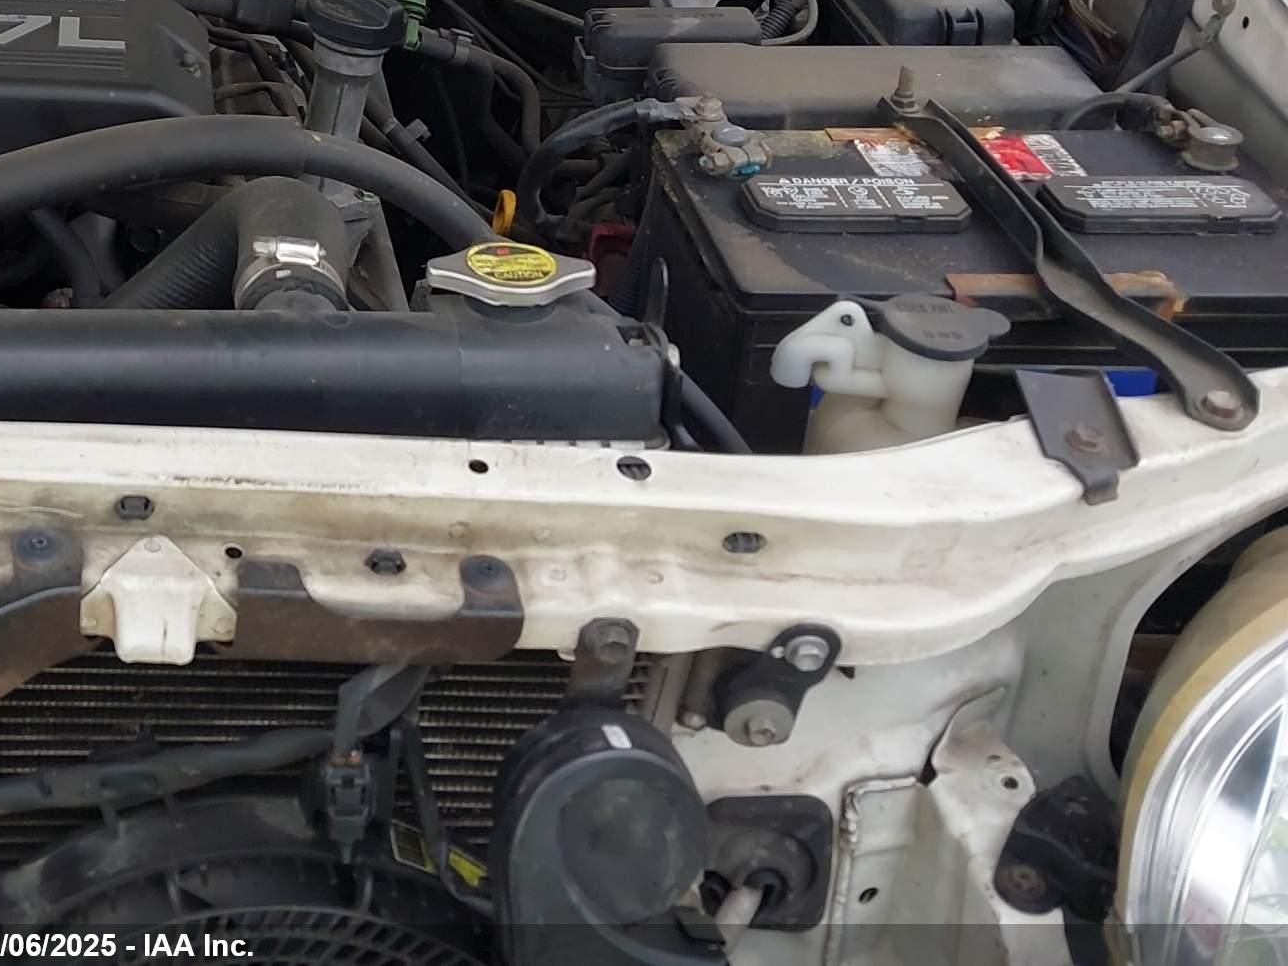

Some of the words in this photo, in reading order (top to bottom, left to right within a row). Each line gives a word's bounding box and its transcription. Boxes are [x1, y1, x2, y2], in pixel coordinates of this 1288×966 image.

[791, 177, 848, 185] DANGER
[863, 177, 916, 186] POISON
[494, 268, 545, 280] CAUTION
